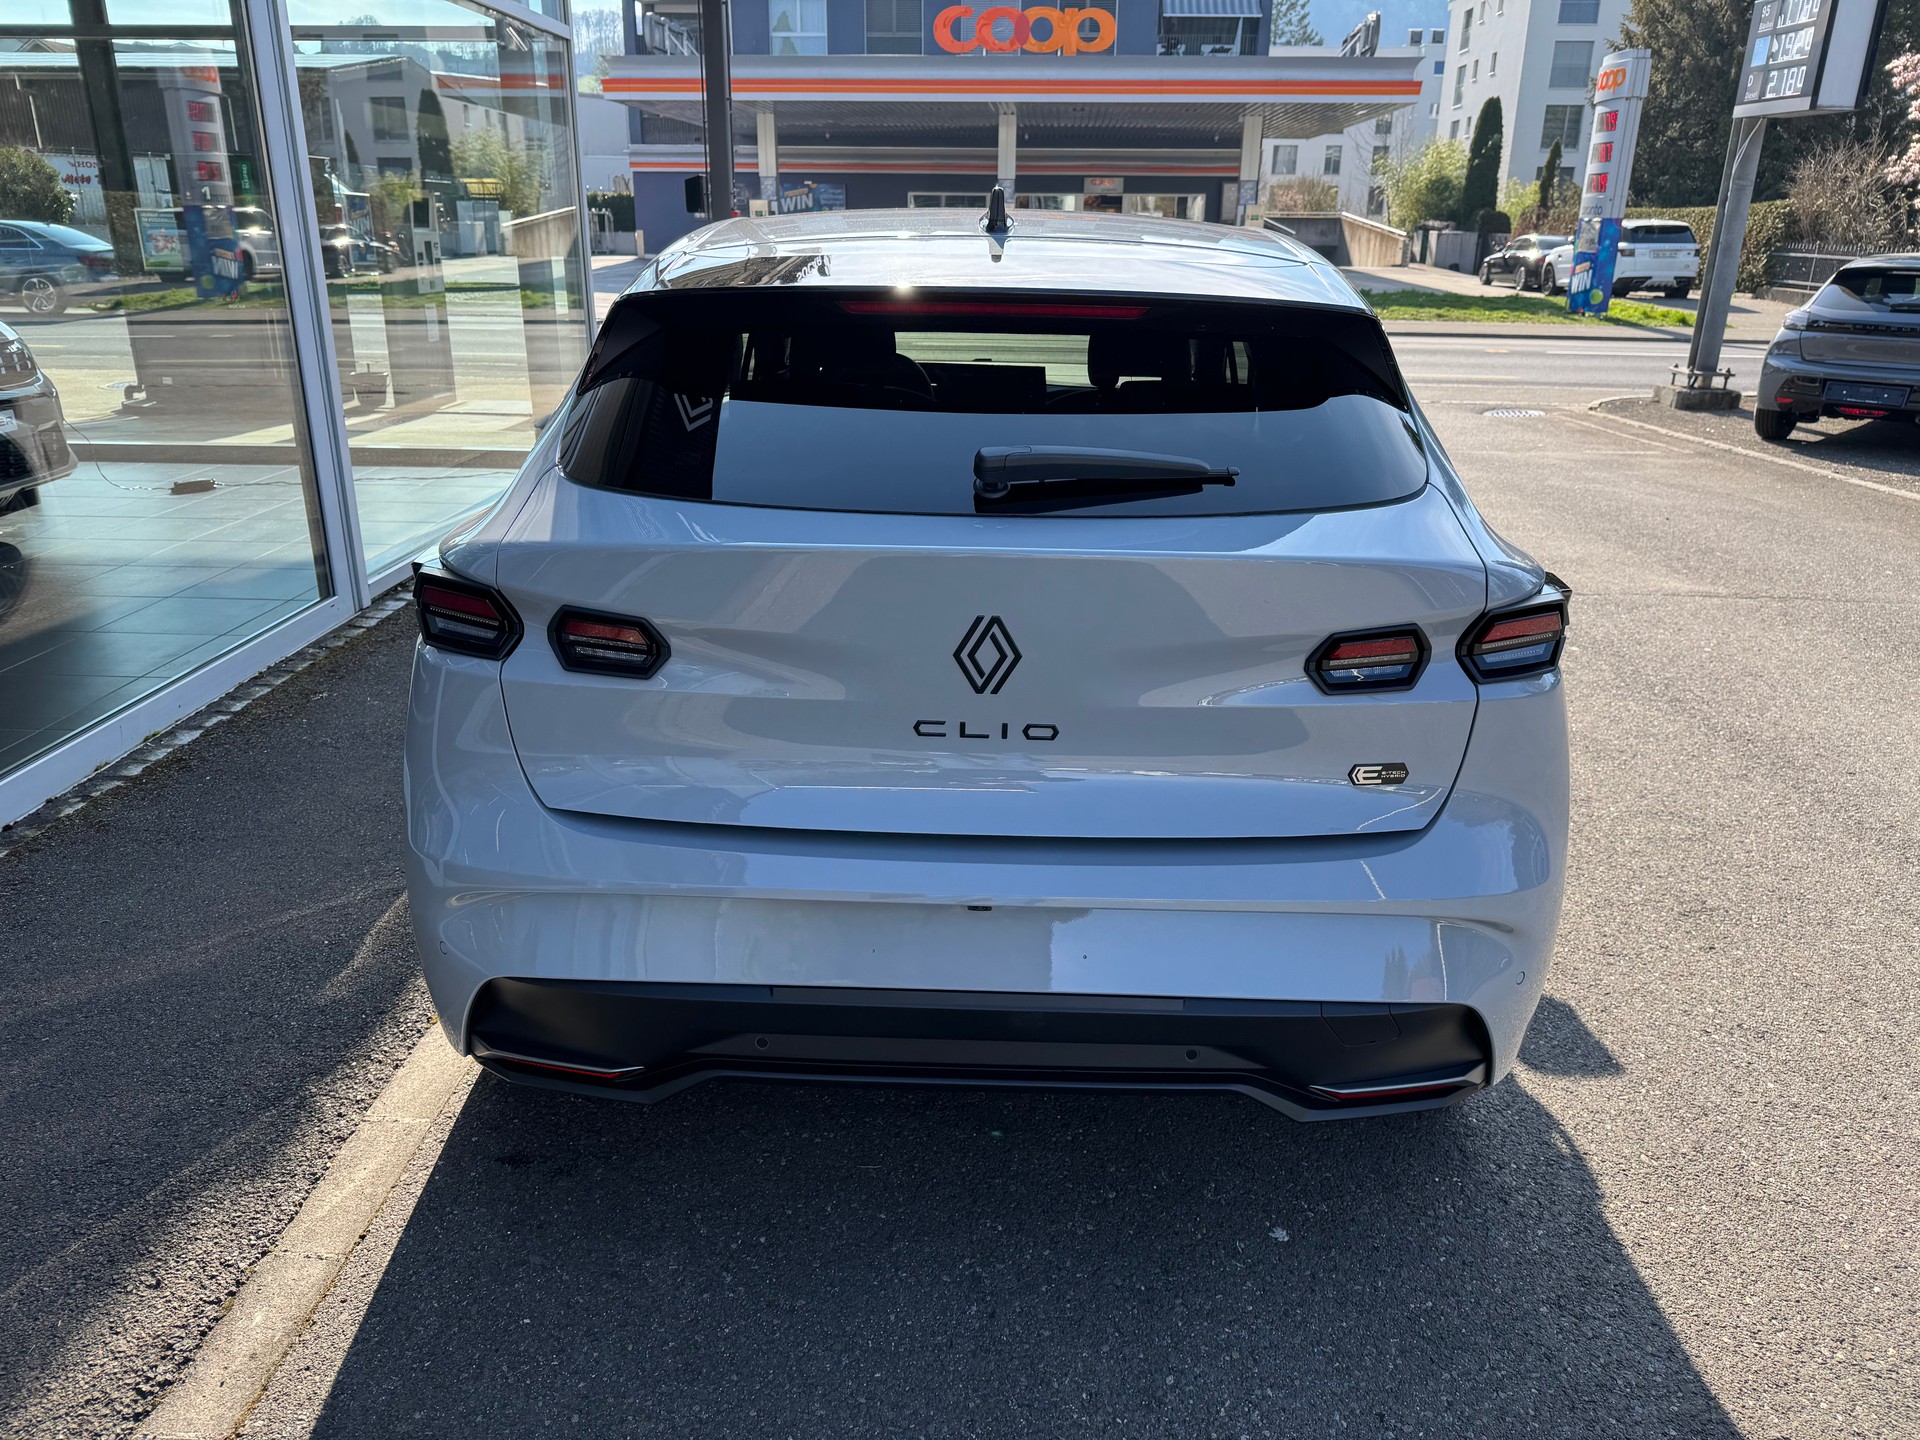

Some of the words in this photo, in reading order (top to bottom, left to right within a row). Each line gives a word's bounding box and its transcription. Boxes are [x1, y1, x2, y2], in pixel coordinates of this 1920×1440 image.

[1761, 5, 1771, 18] 95
[933, 5, 1116, 56] coop
[780, 193, 814, 213] WIN
[1571, 269, 1593, 295] WIN
[912, 719, 1060, 741] CLIO
